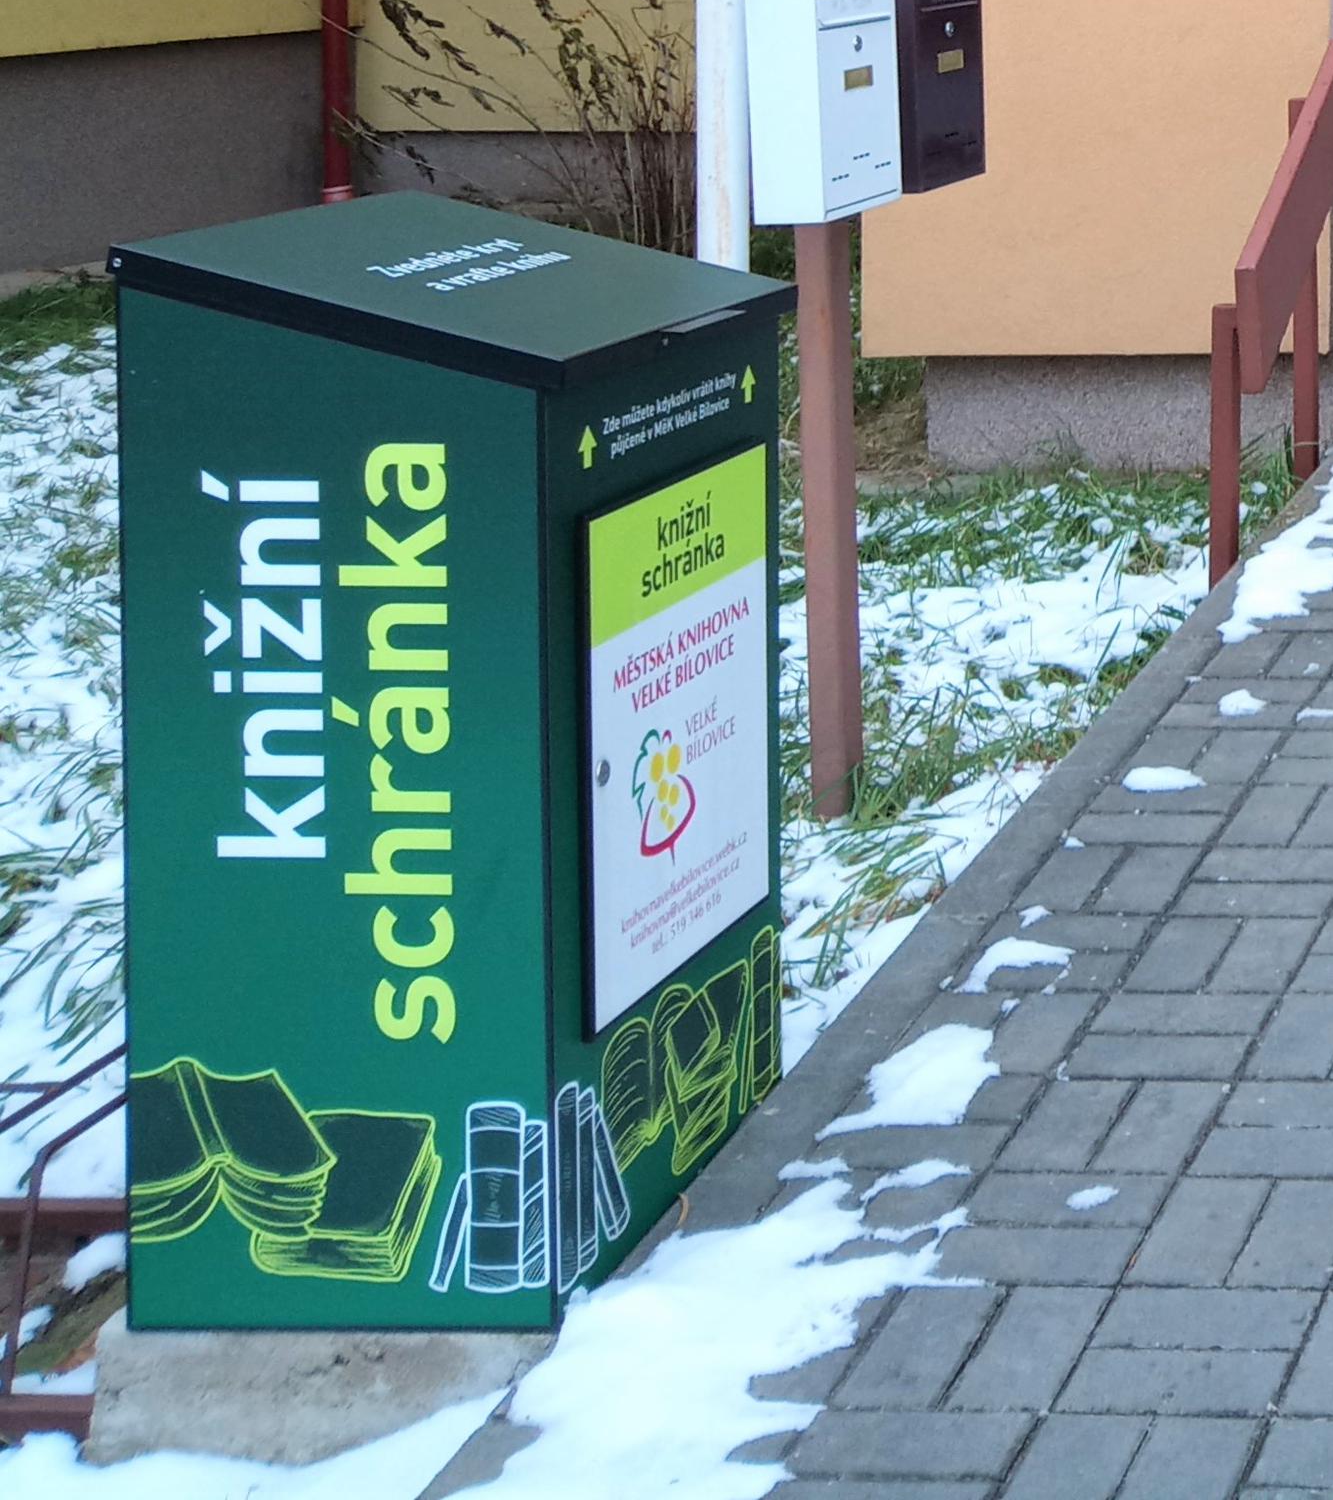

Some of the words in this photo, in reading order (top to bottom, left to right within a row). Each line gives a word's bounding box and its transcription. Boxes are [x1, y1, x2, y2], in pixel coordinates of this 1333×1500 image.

[426, 281, 455, 291] a
[496, 251, 572, 271] knihu
[462, 237, 524, 255] kryt
[602, 416, 621, 435] Zde
[621, 404, 655, 428] můžete
[656, 388, 691, 414] kdykoliv
[692, 379, 714, 400] vrátit
[715, 372, 737, 392] knihy
[610, 426, 646, 460] půjčené
[646, 428, 653, 440] v
[675, 406, 698, 429] Velké
[699, 396, 730, 420] Bílovice
[657, 490, 711, 551] knižní
[641, 532, 725, 597] schránka
[201, 470, 326, 859] knižní
[613, 631, 674, 693] MĚSTSKÁ
[678, 596, 749, 655] KNIHOVNA
[632, 664, 671, 713] VELKÉ
[675, 633, 735, 688] BÍLOVICE
[331, 442, 457, 1044] schránka
[685, 695, 718, 736] VELKÉ
[686, 716, 735, 765] BÍLOVICE
